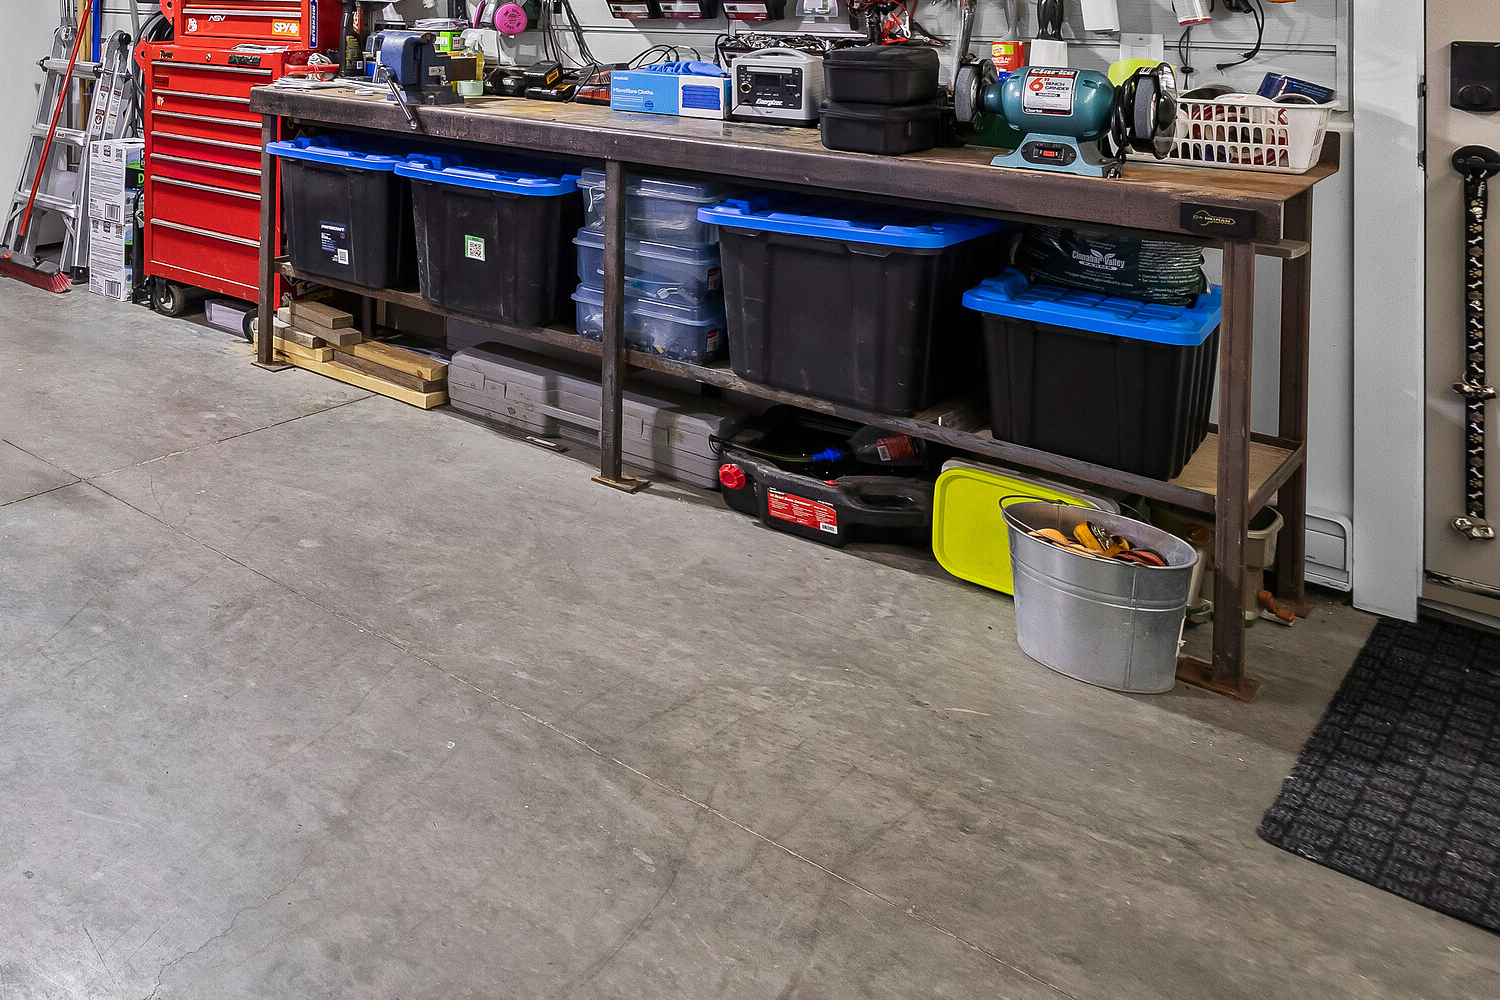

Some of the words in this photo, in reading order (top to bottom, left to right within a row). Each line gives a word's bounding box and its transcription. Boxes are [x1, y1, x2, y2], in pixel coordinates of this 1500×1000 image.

[1030, 68, 1076, 76] Clarke
[612, 87, 638, 95] Microfibre
[638, 88, 654, 96] Cloths
[755, 98, 784, 107] Energizer
[1071, 249, 1103, 265] Cinnabar
[1104, 255, 1126, 269] Valley
